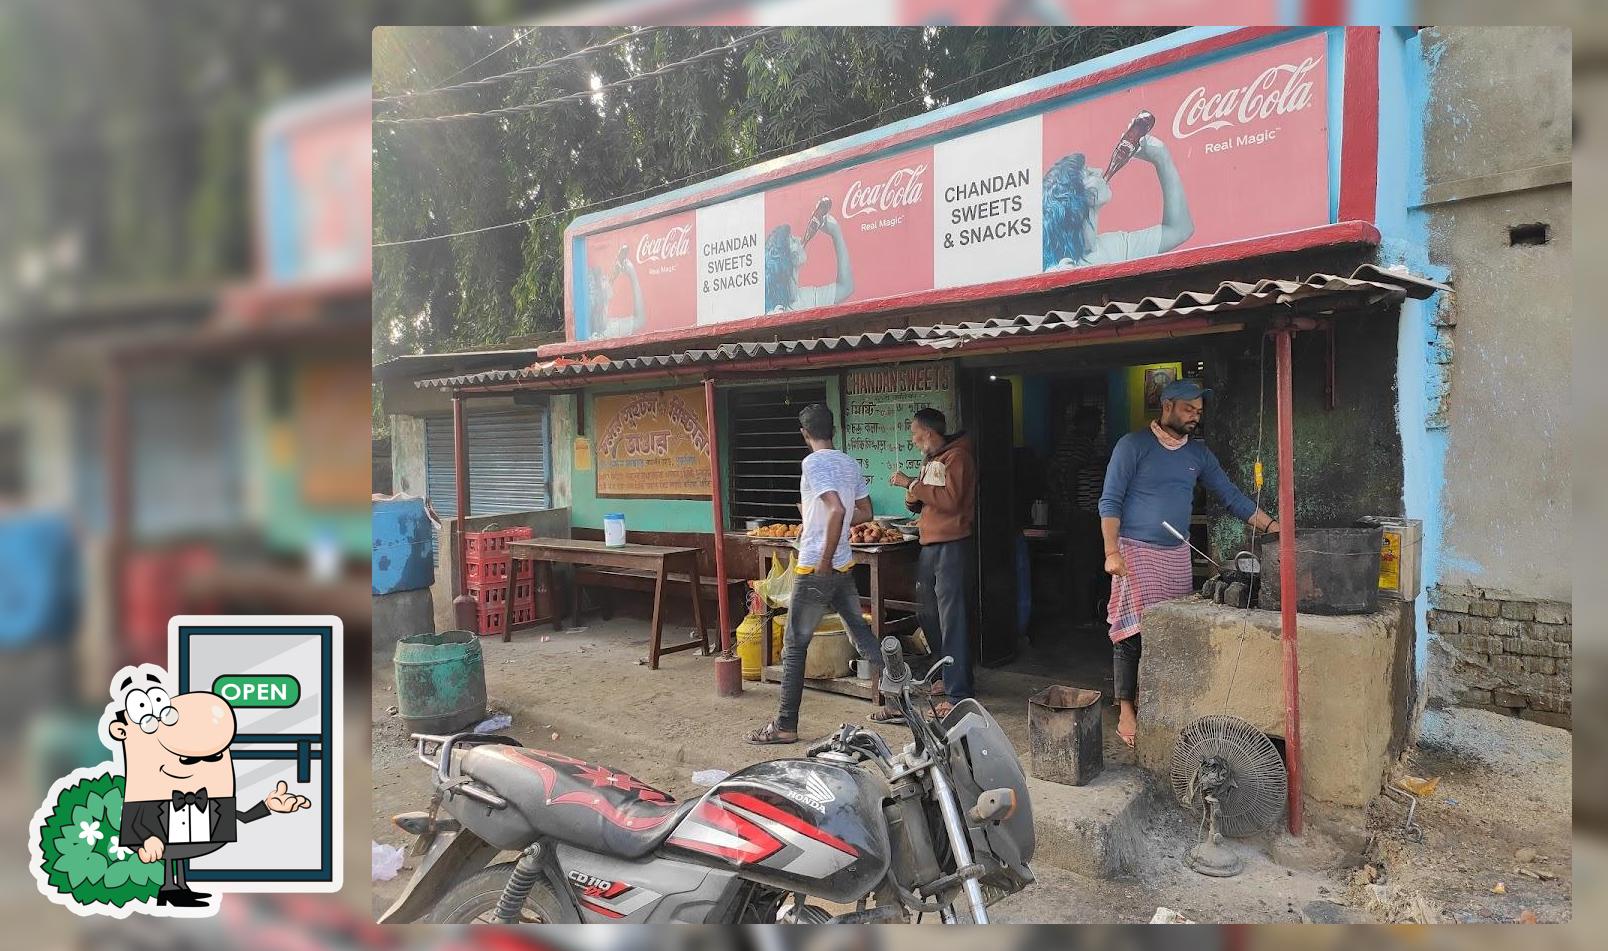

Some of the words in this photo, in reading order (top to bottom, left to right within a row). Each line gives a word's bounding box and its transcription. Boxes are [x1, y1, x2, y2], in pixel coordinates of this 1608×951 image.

[1172, 55, 1323, 139] Coca-Cola
[1205, 139, 1232, 154] Real
[842, 162, 928, 218] Coca-Cola
[944, 168, 1029, 203] CHANDAN
[951, 195, 1022, 225] SWEETS
[861, 220, 877, 232] Real
[943, 232, 955, 249] &
[959, 216, 1032, 246] SNACKS
[636, 223, 692, 264] Coca-Cola
[703, 233, 757, 257] CHANDAN
[707, 253, 753, 274] SWEETS
[702, 280, 711, 293] &
[713, 271, 758, 292] SNACKS
[846, 368, 899, 395] CHANDAN
[899, 364, 951, 392] SWEETS
[787, 790, 826, 815] HONDA
